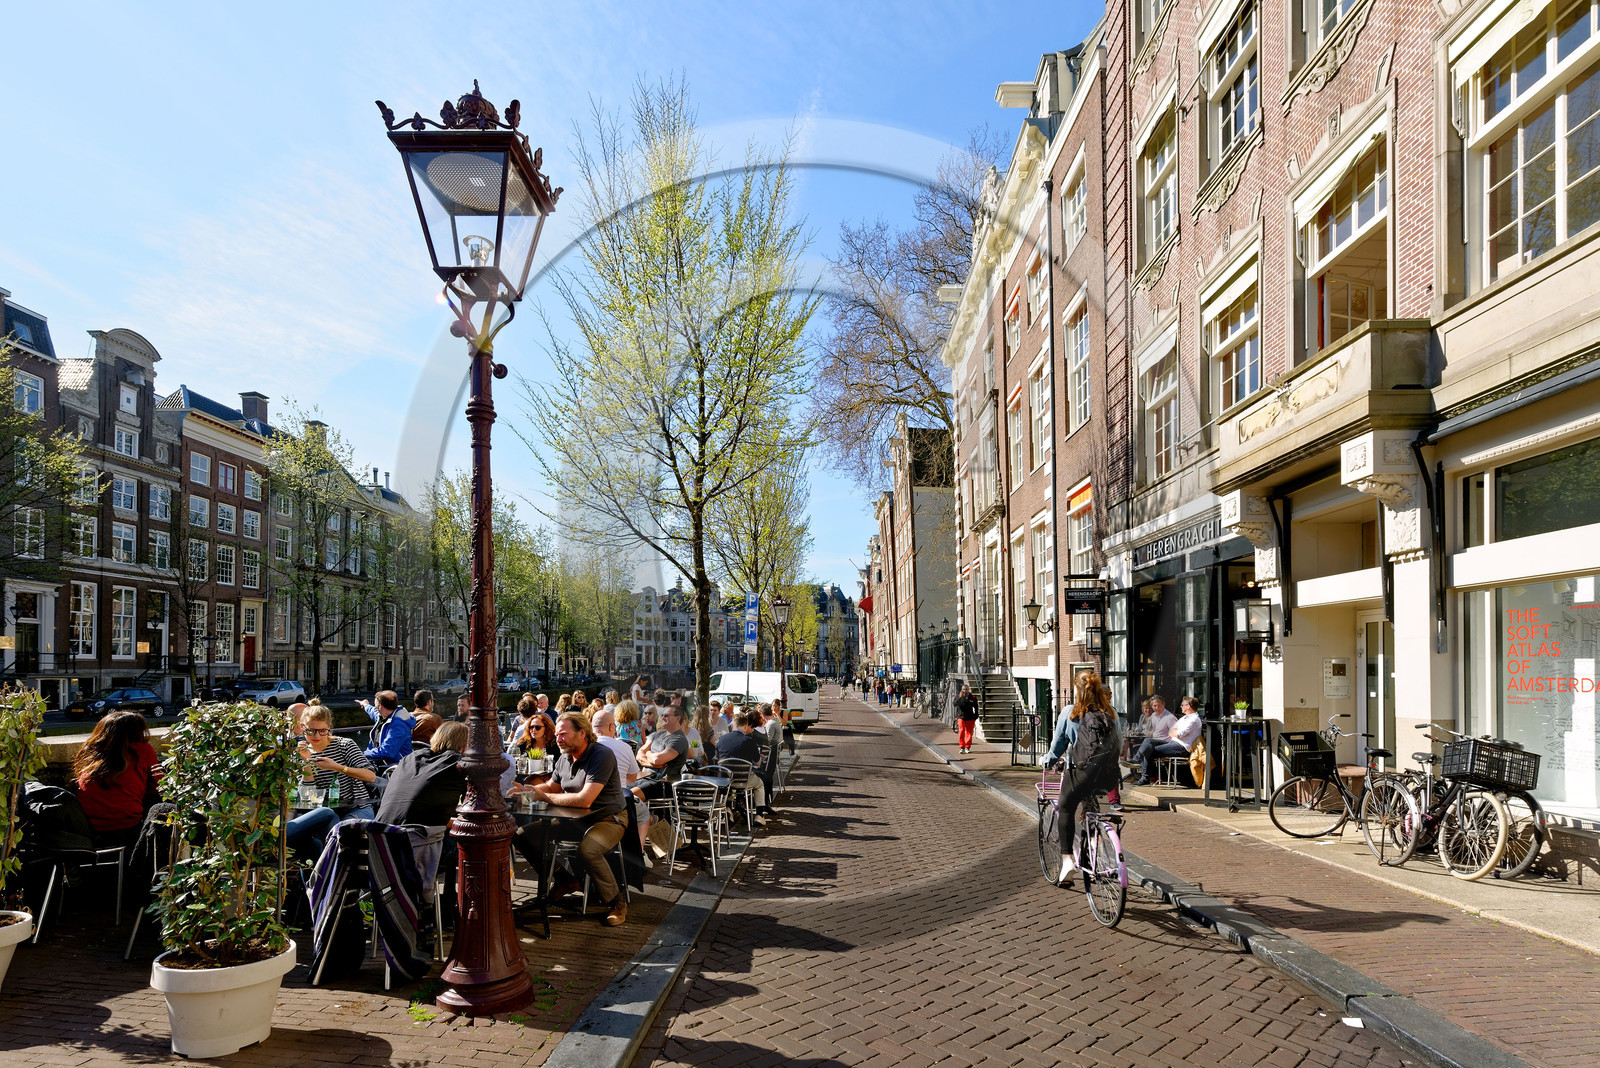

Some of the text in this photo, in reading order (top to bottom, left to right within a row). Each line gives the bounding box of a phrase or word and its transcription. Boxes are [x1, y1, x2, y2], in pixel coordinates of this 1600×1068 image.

[1146, 517, 1222, 560] HERENGRACHT
[749, 594, 757, 606] P
[1506, 607, 1540, 624] THE
[748, 622, 756, 635] P
[1507, 624, 1552, 641] SOFT
[1506, 641, 1561, 658] ATLAS
[1507, 659, 1531, 675] OF
